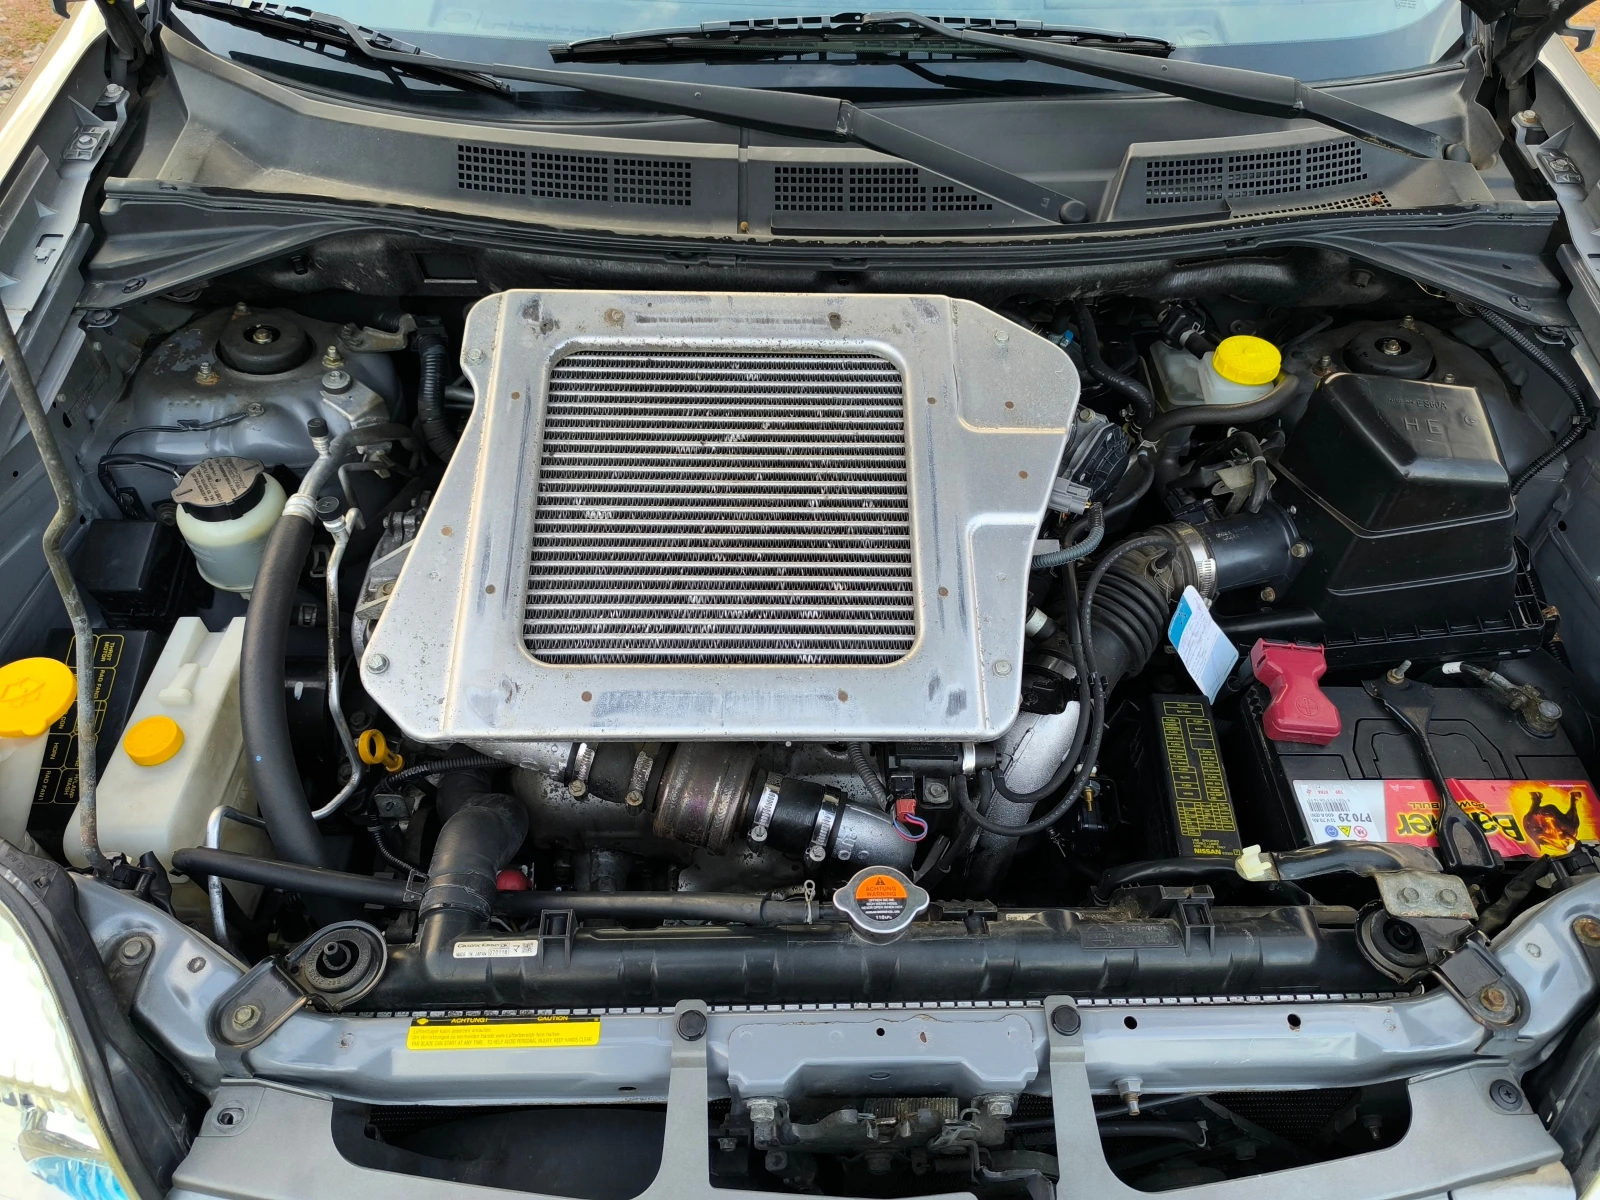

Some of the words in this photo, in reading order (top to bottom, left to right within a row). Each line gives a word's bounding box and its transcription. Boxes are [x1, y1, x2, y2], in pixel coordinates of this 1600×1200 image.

[100, 641, 109, 662] MOTOR
[106, 641, 116, 661] THROT
[97, 669, 106, 682] RAD
[49, 742, 60, 760] HORN
[43, 770, 52, 784] RAD
[37, 785, 48, 800] FAN1
[63, 777, 73, 796] WASH
[1338, 812, 1351, 823] 29
[1352, 812, 1372, 823] P70
